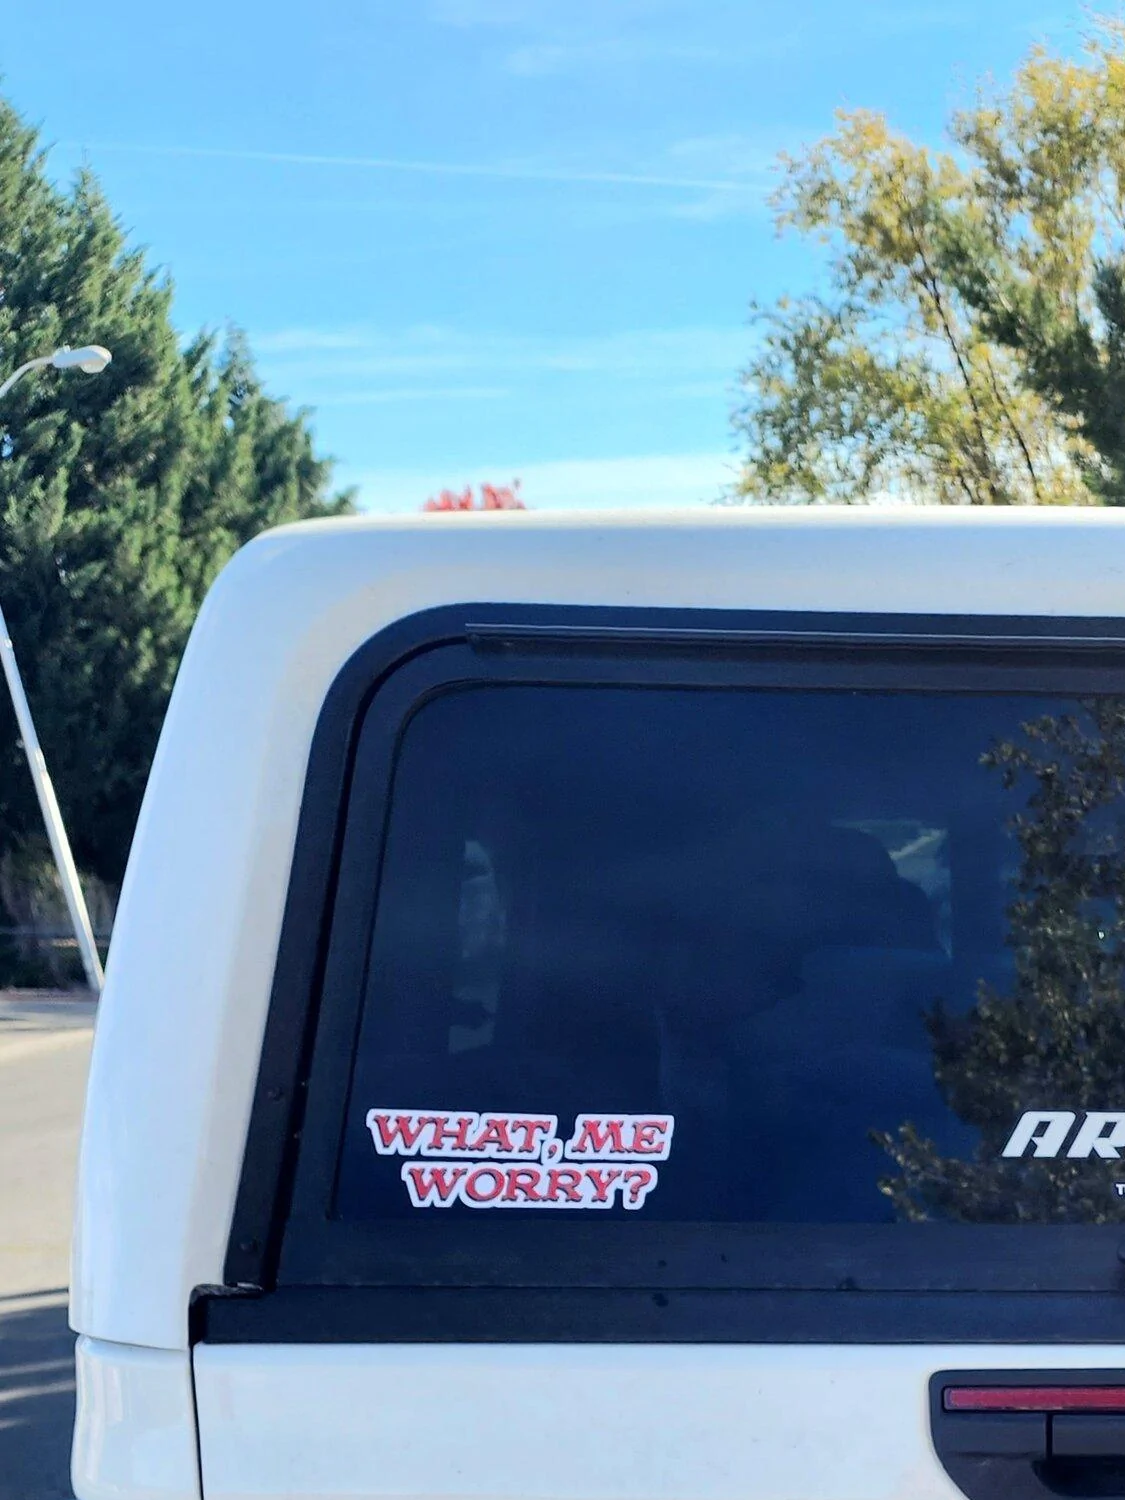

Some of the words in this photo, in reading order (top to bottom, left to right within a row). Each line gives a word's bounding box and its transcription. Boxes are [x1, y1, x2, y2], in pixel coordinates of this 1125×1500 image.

[373, 1114, 558, 1160] WHAT,
[572, 1119, 668, 1154] ME
[408, 1167, 652, 1204] WORRY?
